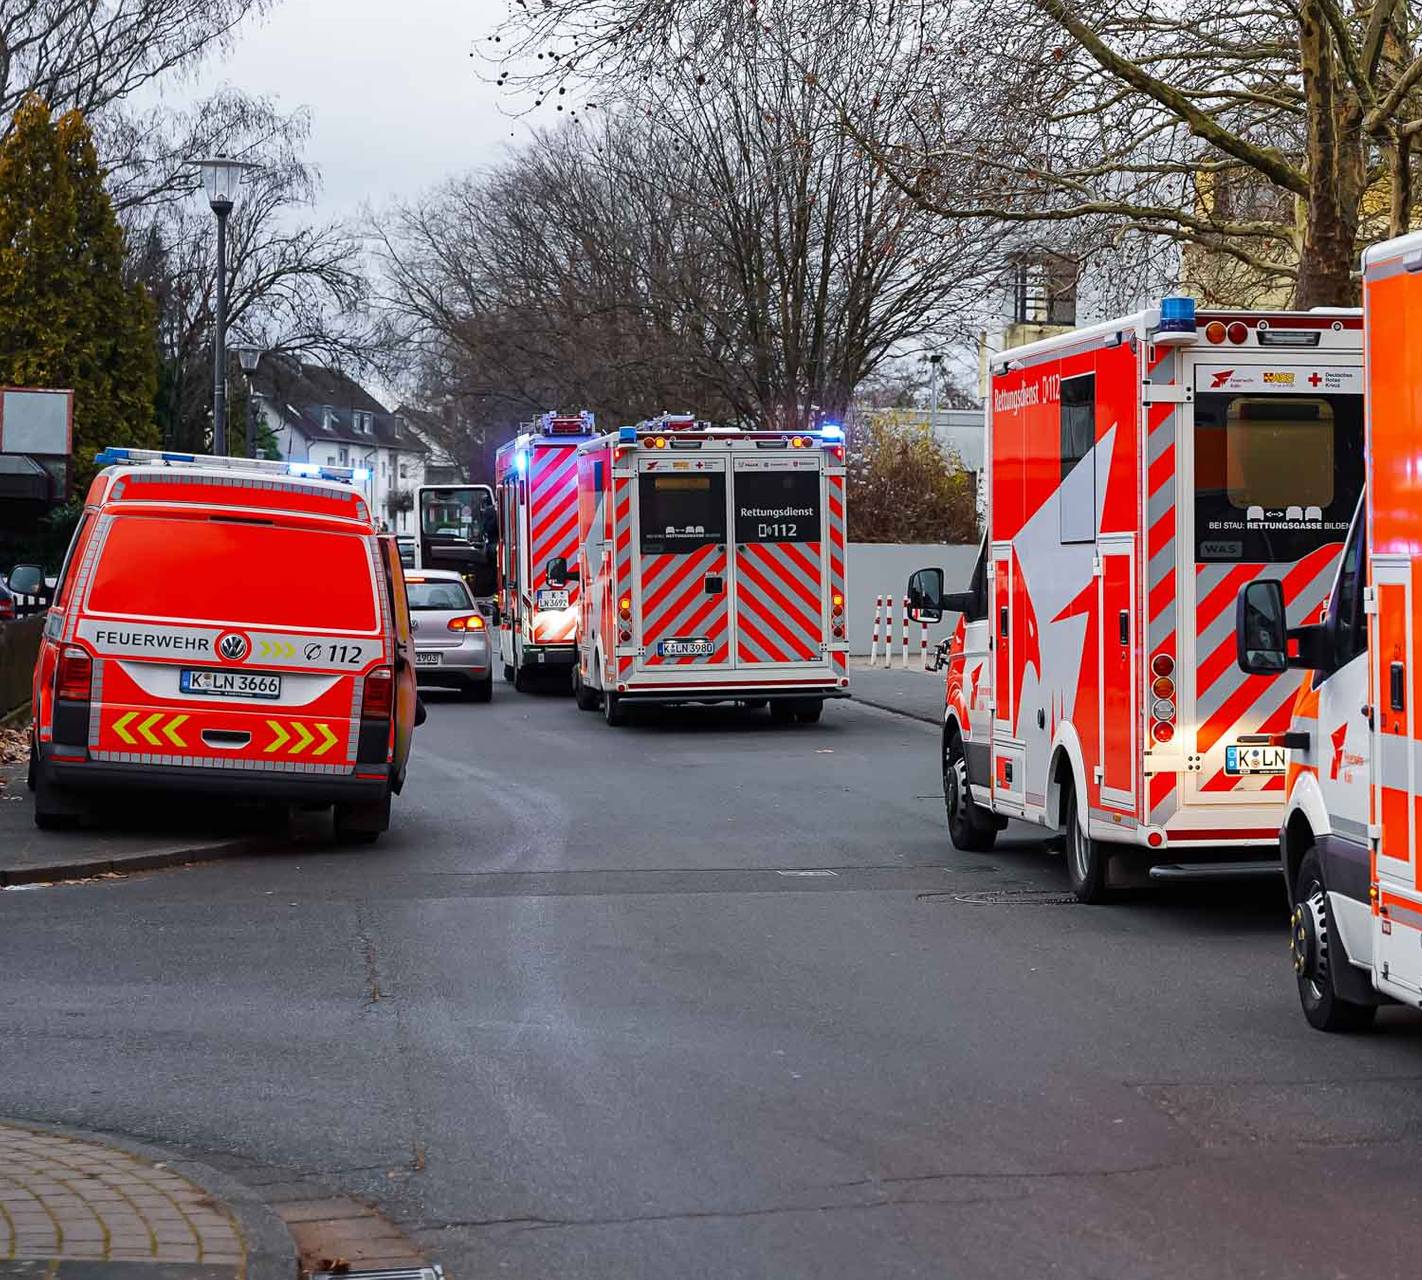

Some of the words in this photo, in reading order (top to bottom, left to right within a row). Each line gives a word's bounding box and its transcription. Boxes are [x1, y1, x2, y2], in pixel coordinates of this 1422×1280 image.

[994, 379, 1039, 416] Rettungsdienst
[1048, 373, 1060, 402] 112
[740, 507, 814, 519] Rettungsdienst
[772, 523, 797, 537] 112
[1208, 522, 1222, 530] BEI
[1223, 522, 1246, 530] STAU:
[1246, 522, 1323, 530] RETTUNGSGASSE
[1324, 522, 1351, 530] BILDEN
[1204, 543, 1236, 554] WAS
[96, 630, 209, 652] FEUERWEHR
[328, 644, 363, 664] 112
[191, 672, 203, 688] K
[213, 674, 235, 690] LN
[238, 676, 278, 693] 3666
[1239, 749, 1250, 767] K
[1263, 749, 1285, 767] LN
